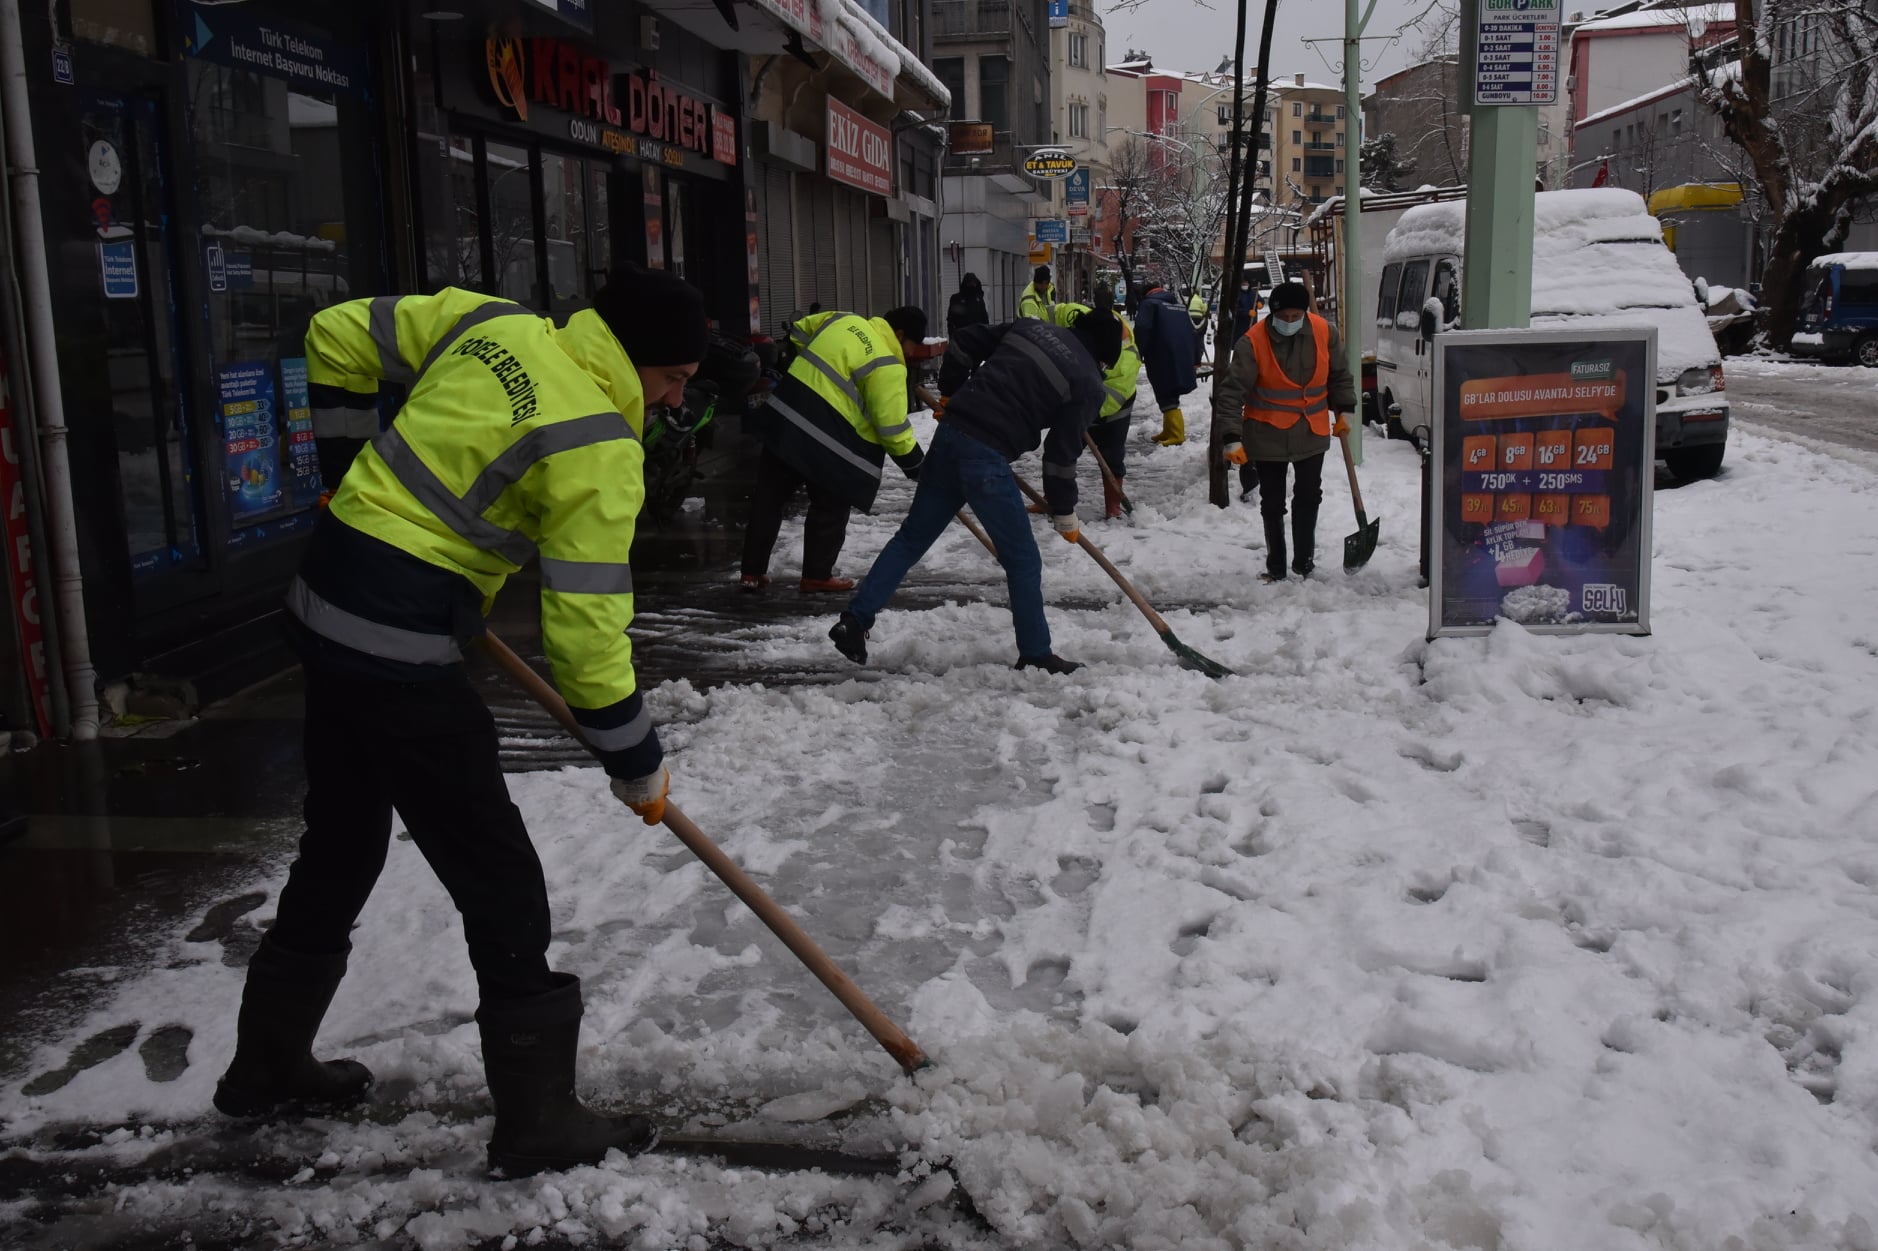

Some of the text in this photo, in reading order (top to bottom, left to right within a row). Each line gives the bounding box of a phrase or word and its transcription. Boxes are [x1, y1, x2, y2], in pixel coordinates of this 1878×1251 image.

[231, 34, 350, 88] İnternet Başvuru Noktası
[259, 25, 323, 61] Türk Telekom
[532, 37, 708, 154] KRAL DÖNER
[570, 119, 597, 145] ODUN
[639, 140, 660, 160] HATAY
[830, 109, 890, 171] EKİZ GIDA
[1026, 161, 1037, 169] ET
[1046, 161, 1073, 169] TAVUK
[105, 264, 134, 275] İnternet
[1572, 363, 1610, 375] FATURASIZ
[491, 355, 541, 428] BELEDİYESİ
[1464, 385, 1616, 405] GB'LAR DOLUSU AVANTAJ SELFY'DE
